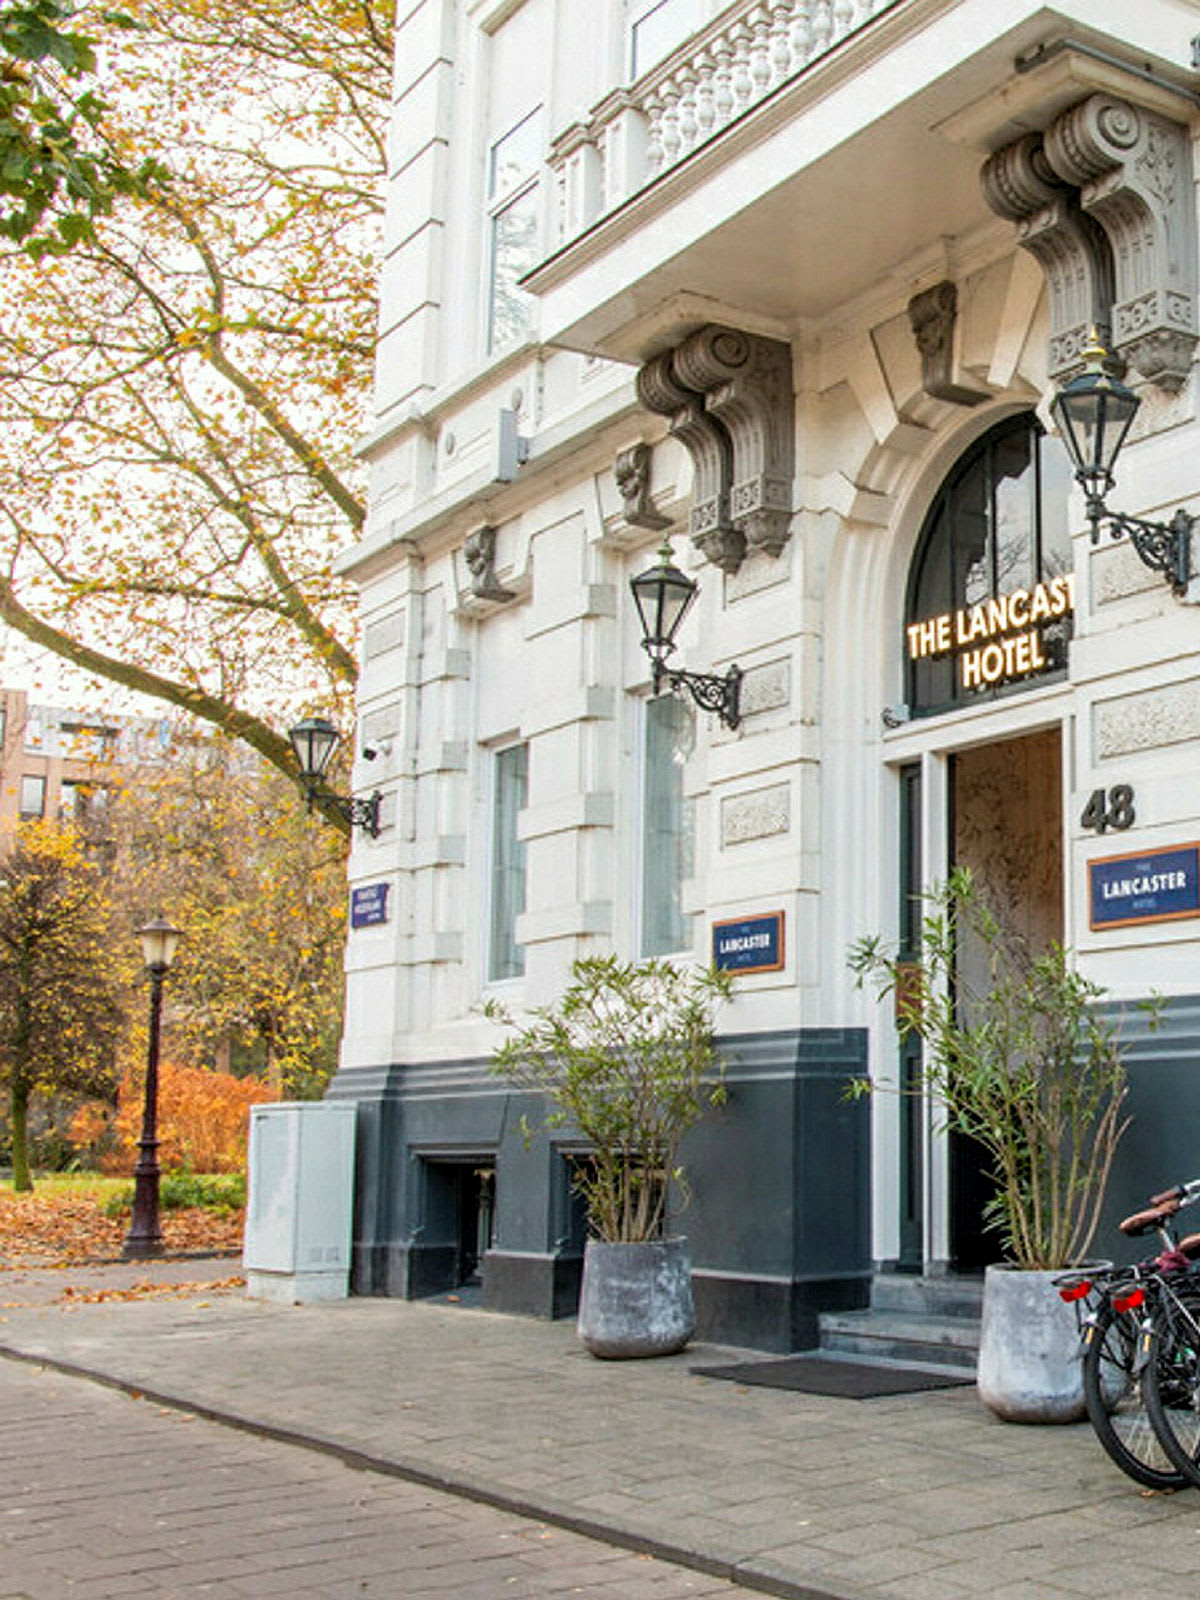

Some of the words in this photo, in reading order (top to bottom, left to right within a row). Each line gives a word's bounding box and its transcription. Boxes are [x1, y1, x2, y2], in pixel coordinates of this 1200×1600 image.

[907, 614, 951, 660] THE
[962, 631, 1045, 688] HOTEL
[1081, 784, 1136, 835] 48
[1103, 871, 1186, 899] LANCASTER
